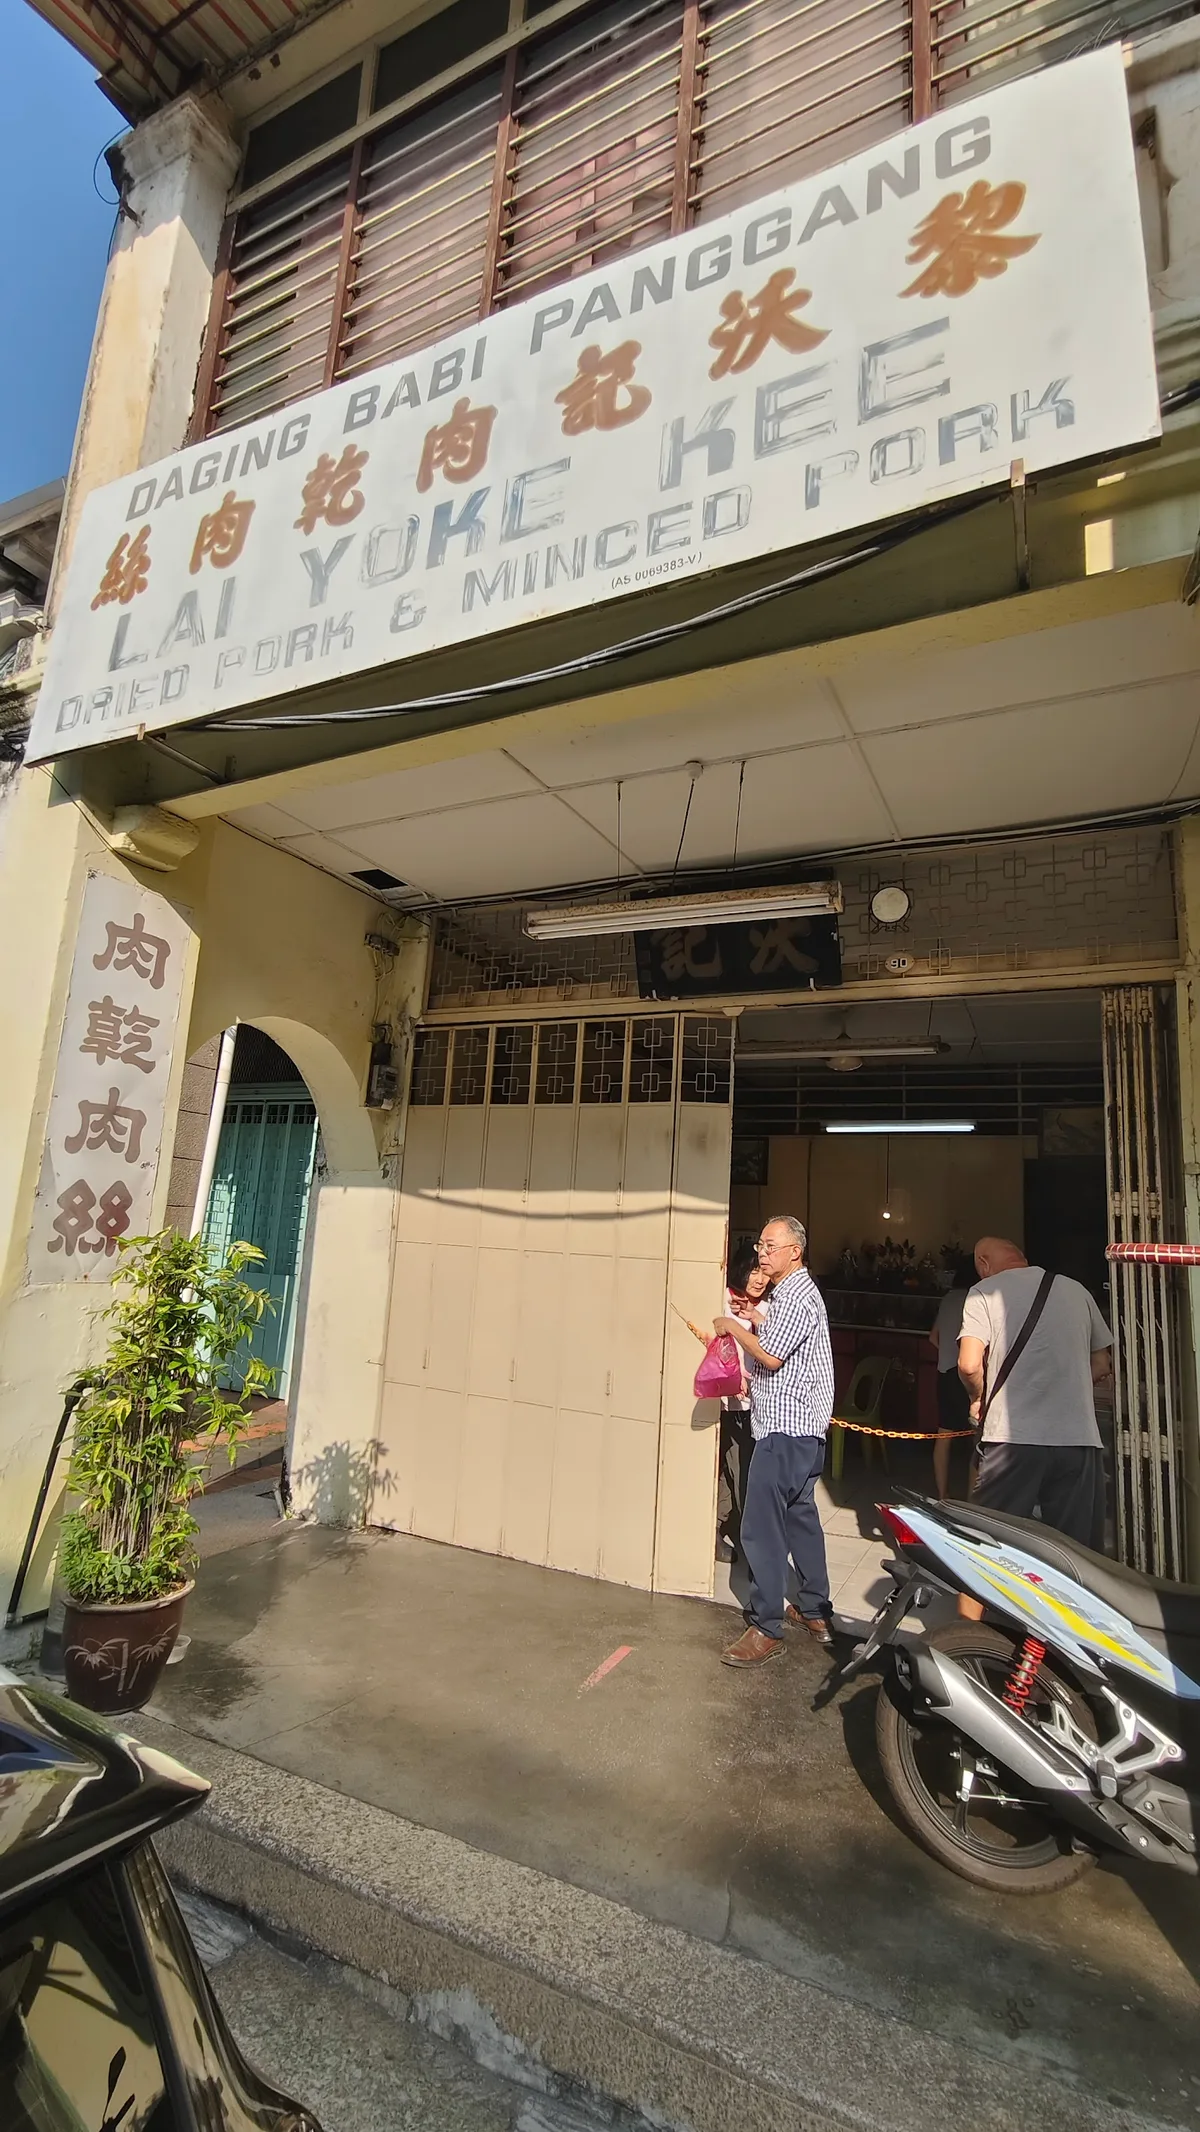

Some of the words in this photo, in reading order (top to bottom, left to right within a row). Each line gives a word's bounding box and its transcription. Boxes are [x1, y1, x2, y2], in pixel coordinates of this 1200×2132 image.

[125, 413, 312, 522] DAGING
[343, 336, 487, 434] BABI
[529, 115, 991, 355] PANGGANG
[55, 663, 190, 734] DRIED
[213, 610, 355, 690] PORK
[389, 588, 427, 633] &
[461, 484, 753, 614] MINCED
[804, 375, 1076, 511] PORK
[108, 576, 236, 672] LAI
[299, 456, 571, 608] YOKE
[658, 316, 951, 491] KEE
[611, 575, 631, 589] (AS
[635, 552, 702, 581] 0069383-V)
[47, 913, 171, 1258] 肉乾肉絲
[890, 957, 908, 969] 90
